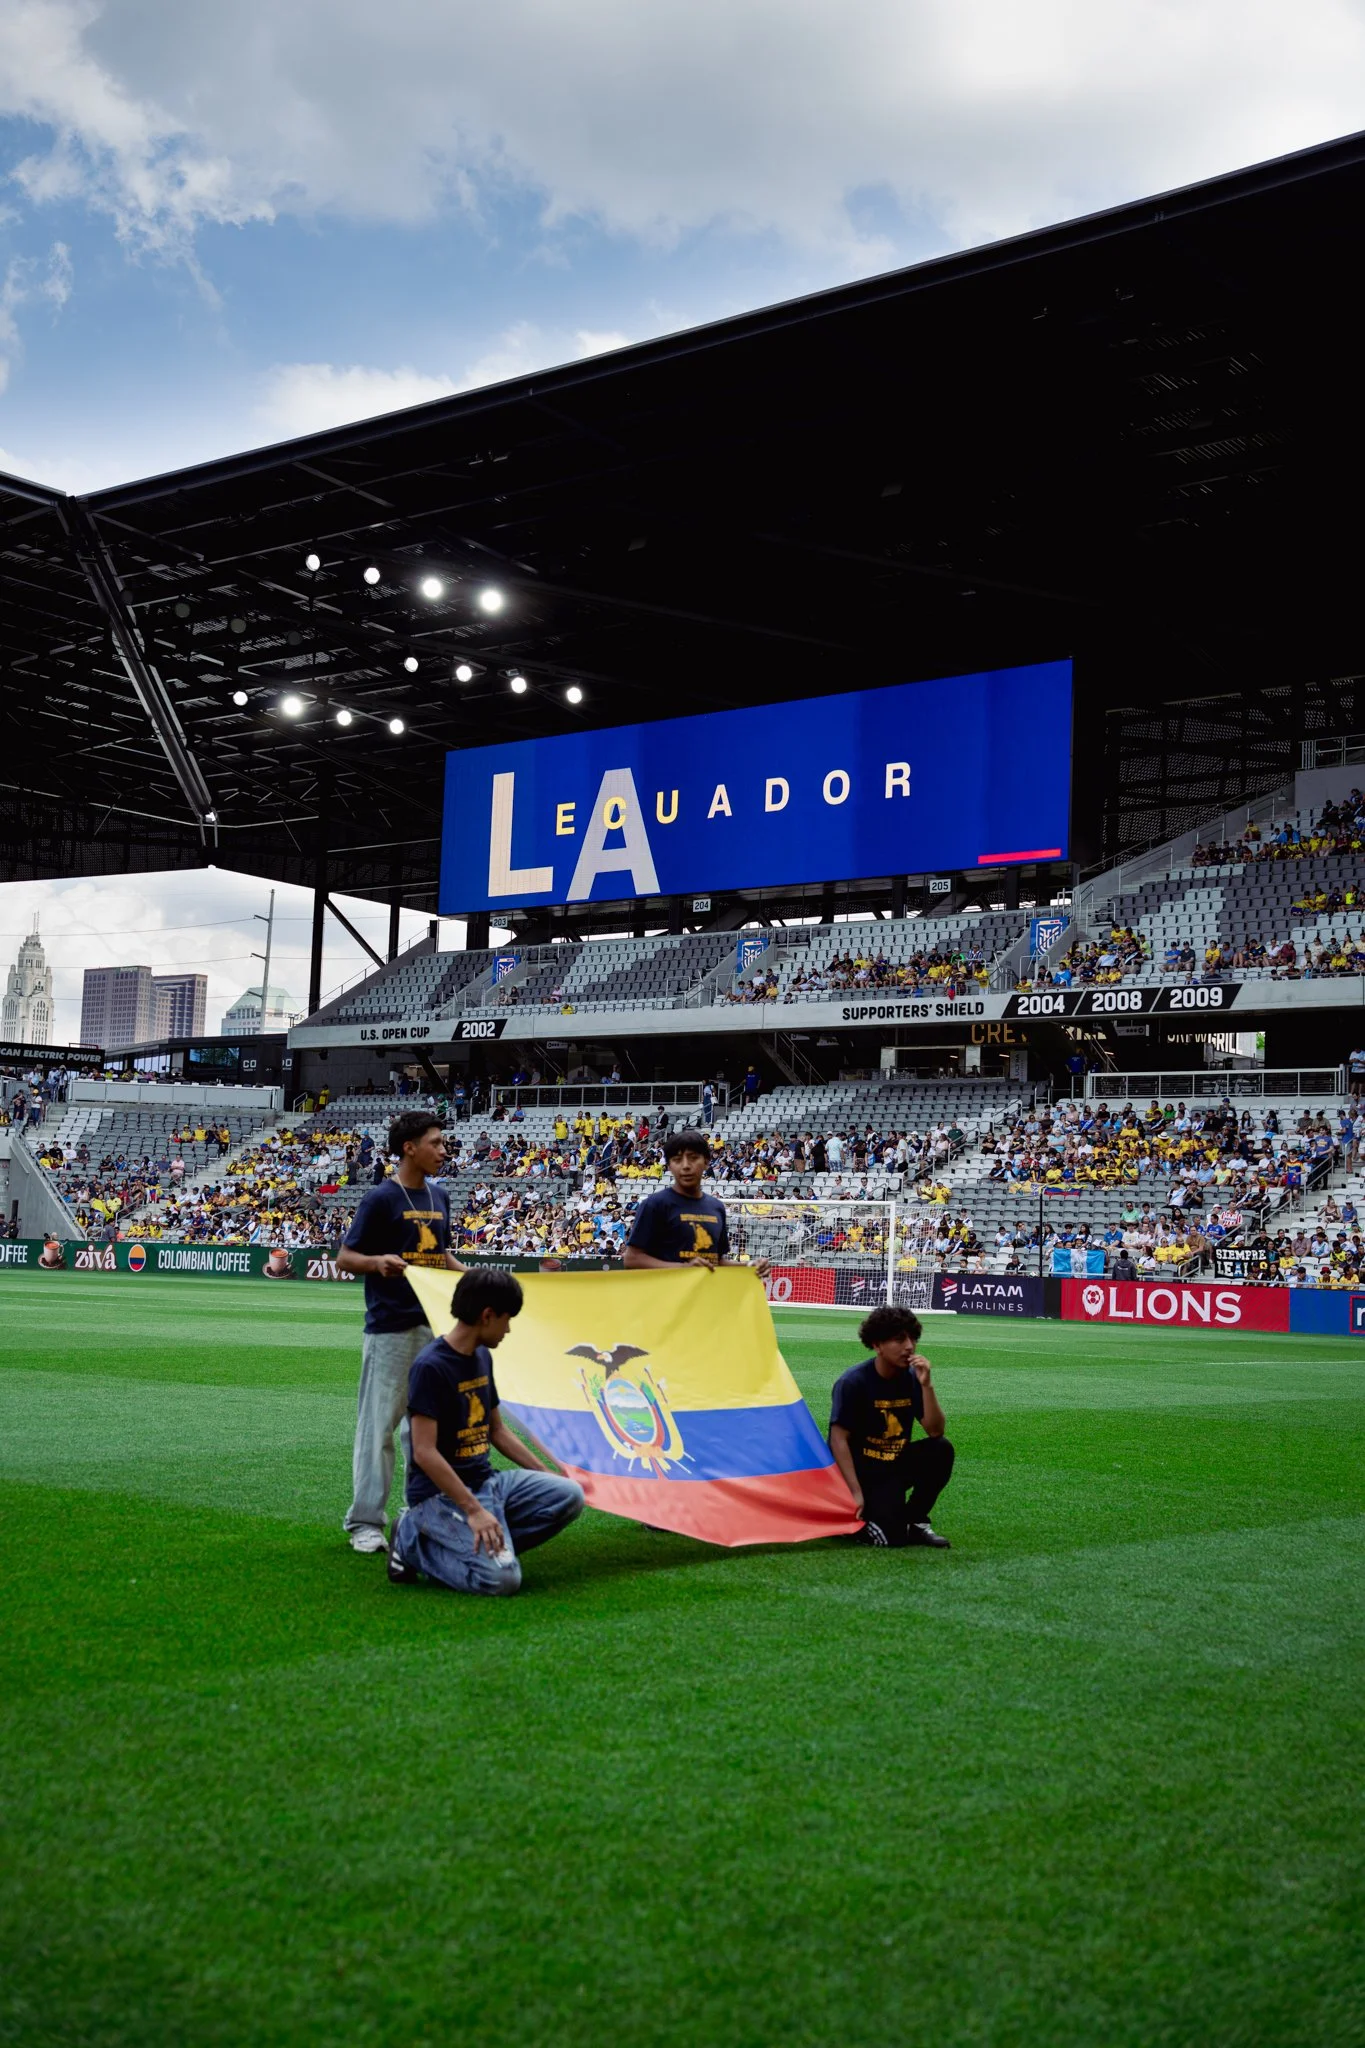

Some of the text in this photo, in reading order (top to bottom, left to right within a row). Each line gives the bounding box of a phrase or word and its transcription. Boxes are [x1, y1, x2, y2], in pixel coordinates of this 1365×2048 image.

[556, 761, 911, 836] ECUADOR
[488, 767, 661, 902] LA
[931, 881, 949, 891] 205
[694, 901, 709, 910] 204
[493, 917, 506, 927] 203
[1017, 994, 1066, 1015] 2004
[1091, 991, 1142, 1012] 2008
[1169, 986, 1223, 1009] 2009
[935, 1001, 985, 1017] SHIELD
[360, 1026, 431, 1041] U.S. OPEN CUP
[461, 1021, 496, 1039] 2002
[971, 1022, 1028, 1045] CRE
[23, 1049, 65, 1060] ELECTRIC
[67, 1052, 101, 1063] POWER
[158, 1249, 251, 1272] COLOMBIAN COFFEE
[1215, 1248, 1267, 1261] SIEMPRE
[869, 1279, 927, 1294] LATAM
[961, 1283, 1024, 1298] LATAM
[961, 1300, 1024, 1312] AIRLINES
[1108, 1286, 1242, 1324] LIONS
